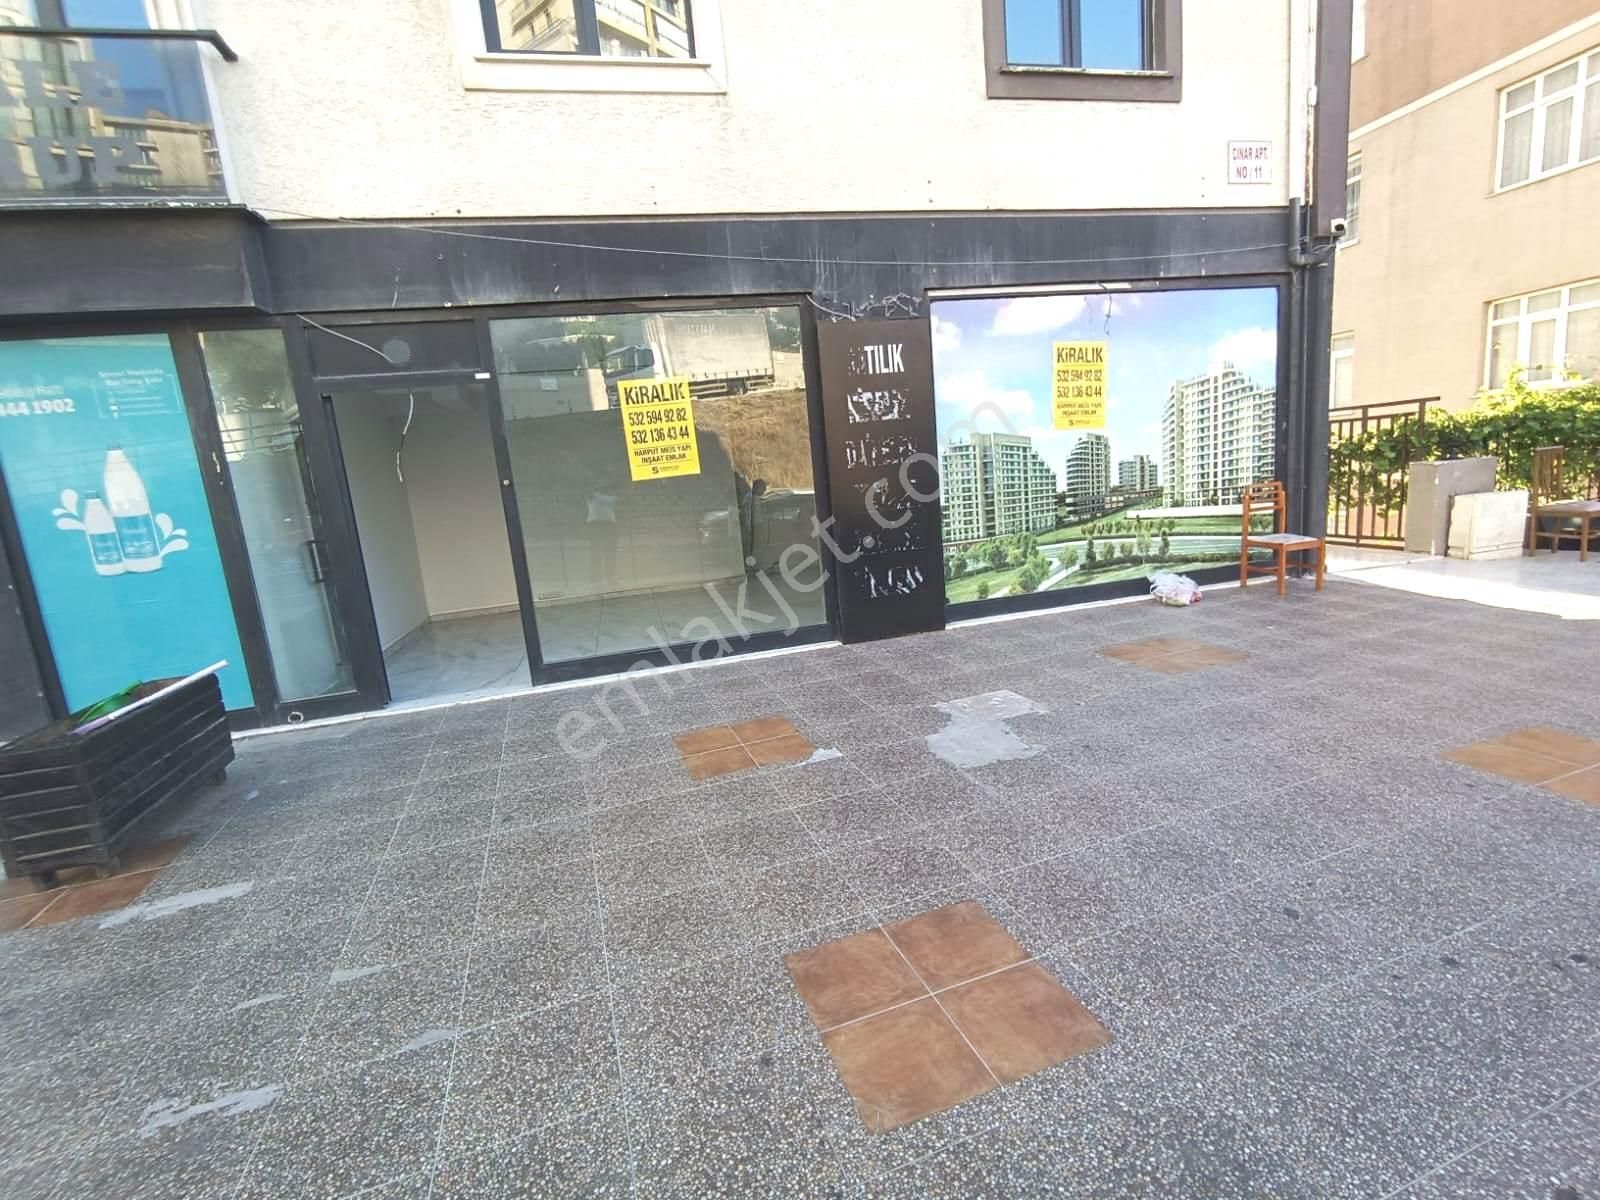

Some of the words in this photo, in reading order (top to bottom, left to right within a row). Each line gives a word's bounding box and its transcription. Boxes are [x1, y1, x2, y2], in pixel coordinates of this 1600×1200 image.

[1236, 165, 1248, 179] NO
[1057, 368, 1070, 383] 532
[1084, 368, 1093, 382] 92
[1057, 385, 1070, 399] 532
[1084, 384, 1093, 398] 43
[1093, 384, 1103, 398] 44
[32, 397, 76, 415] 1902
[628, 411, 645, 427] 532
[646, 409, 663, 425] 594
[663, 408, 676, 423] 92
[676, 407, 688, 422] 82
[631, 429, 648, 445] 532
[650, 427, 665, 443] 136
[667, 426, 678, 441] 43
[679, 424, 690, 440] 44
